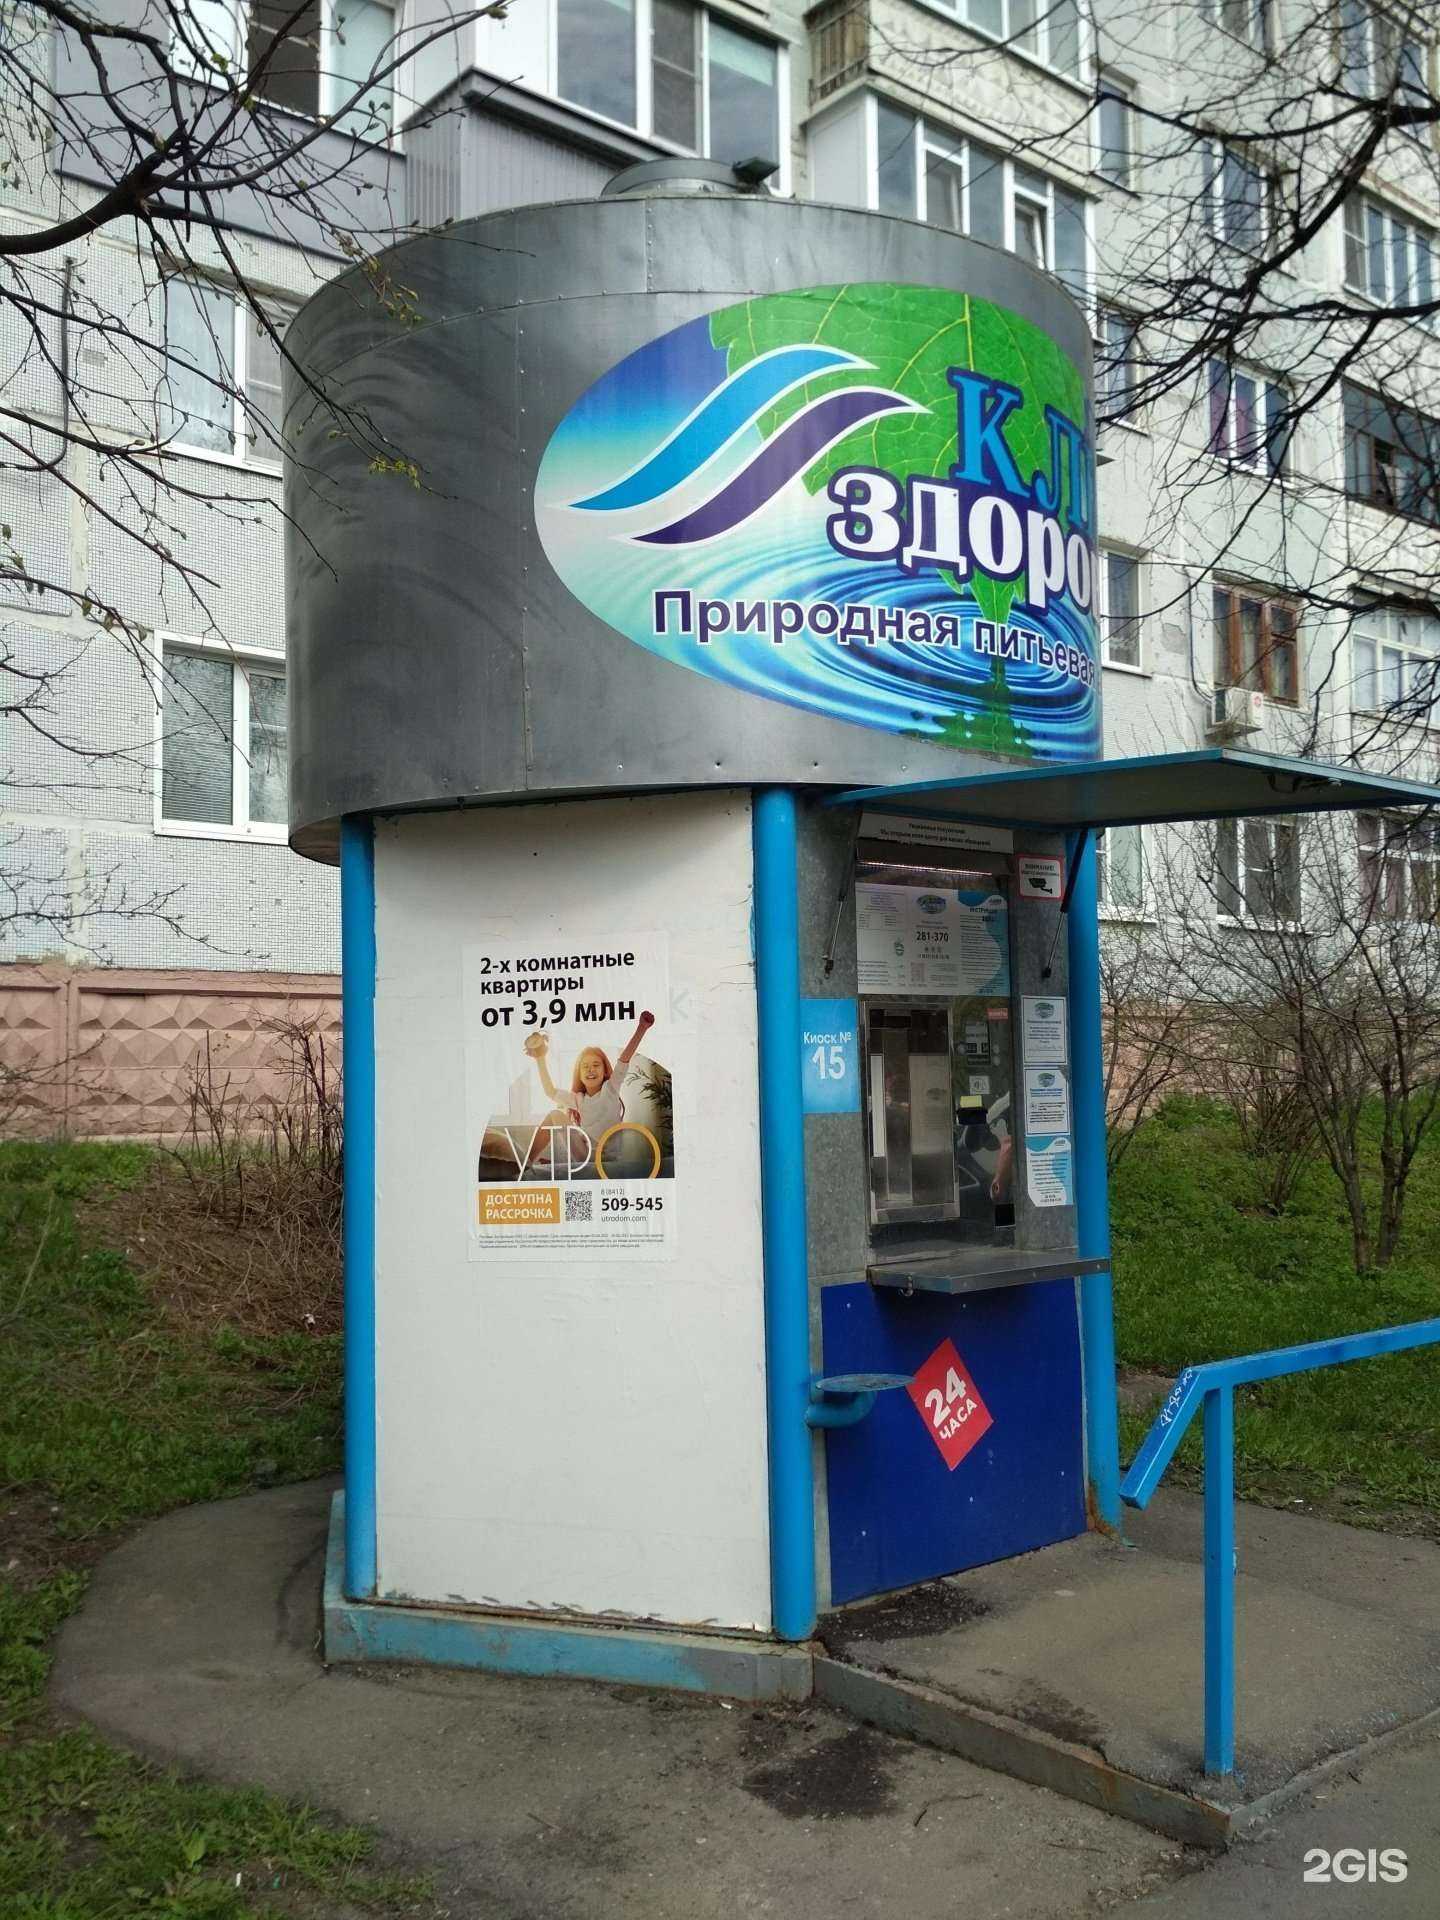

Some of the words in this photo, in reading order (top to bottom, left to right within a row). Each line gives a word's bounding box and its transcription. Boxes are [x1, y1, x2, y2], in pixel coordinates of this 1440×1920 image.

[947, 368, 1092, 532] КЛ
[828, 467, 1099, 616] здоро
[653, 589, 959, 645] Природная
[916, 931, 949, 942] 281-370
[480, 957, 510, 975] 2-х
[516, 951, 635, 973] комнатные
[481, 975, 584, 997] квартиры
[481, 1007, 514, 1027] от
[522, 998, 566, 1029] 3,9
[575, 1000, 635, 1023] млн
[803, 1031, 837, 1044] Киоск
[812, 1046, 845, 1080] 15
[505, 1122, 661, 1182] УТРО
[485, 1193, 553, 1206] ДОСТУПНА
[486, 1207, 553, 1220] РАССРОЧКА
[601, 1197, 663, 1211] 509-545
[924, 1367, 967, 1428] 24
[938, 1398, 978, 1439] ЧАСА
